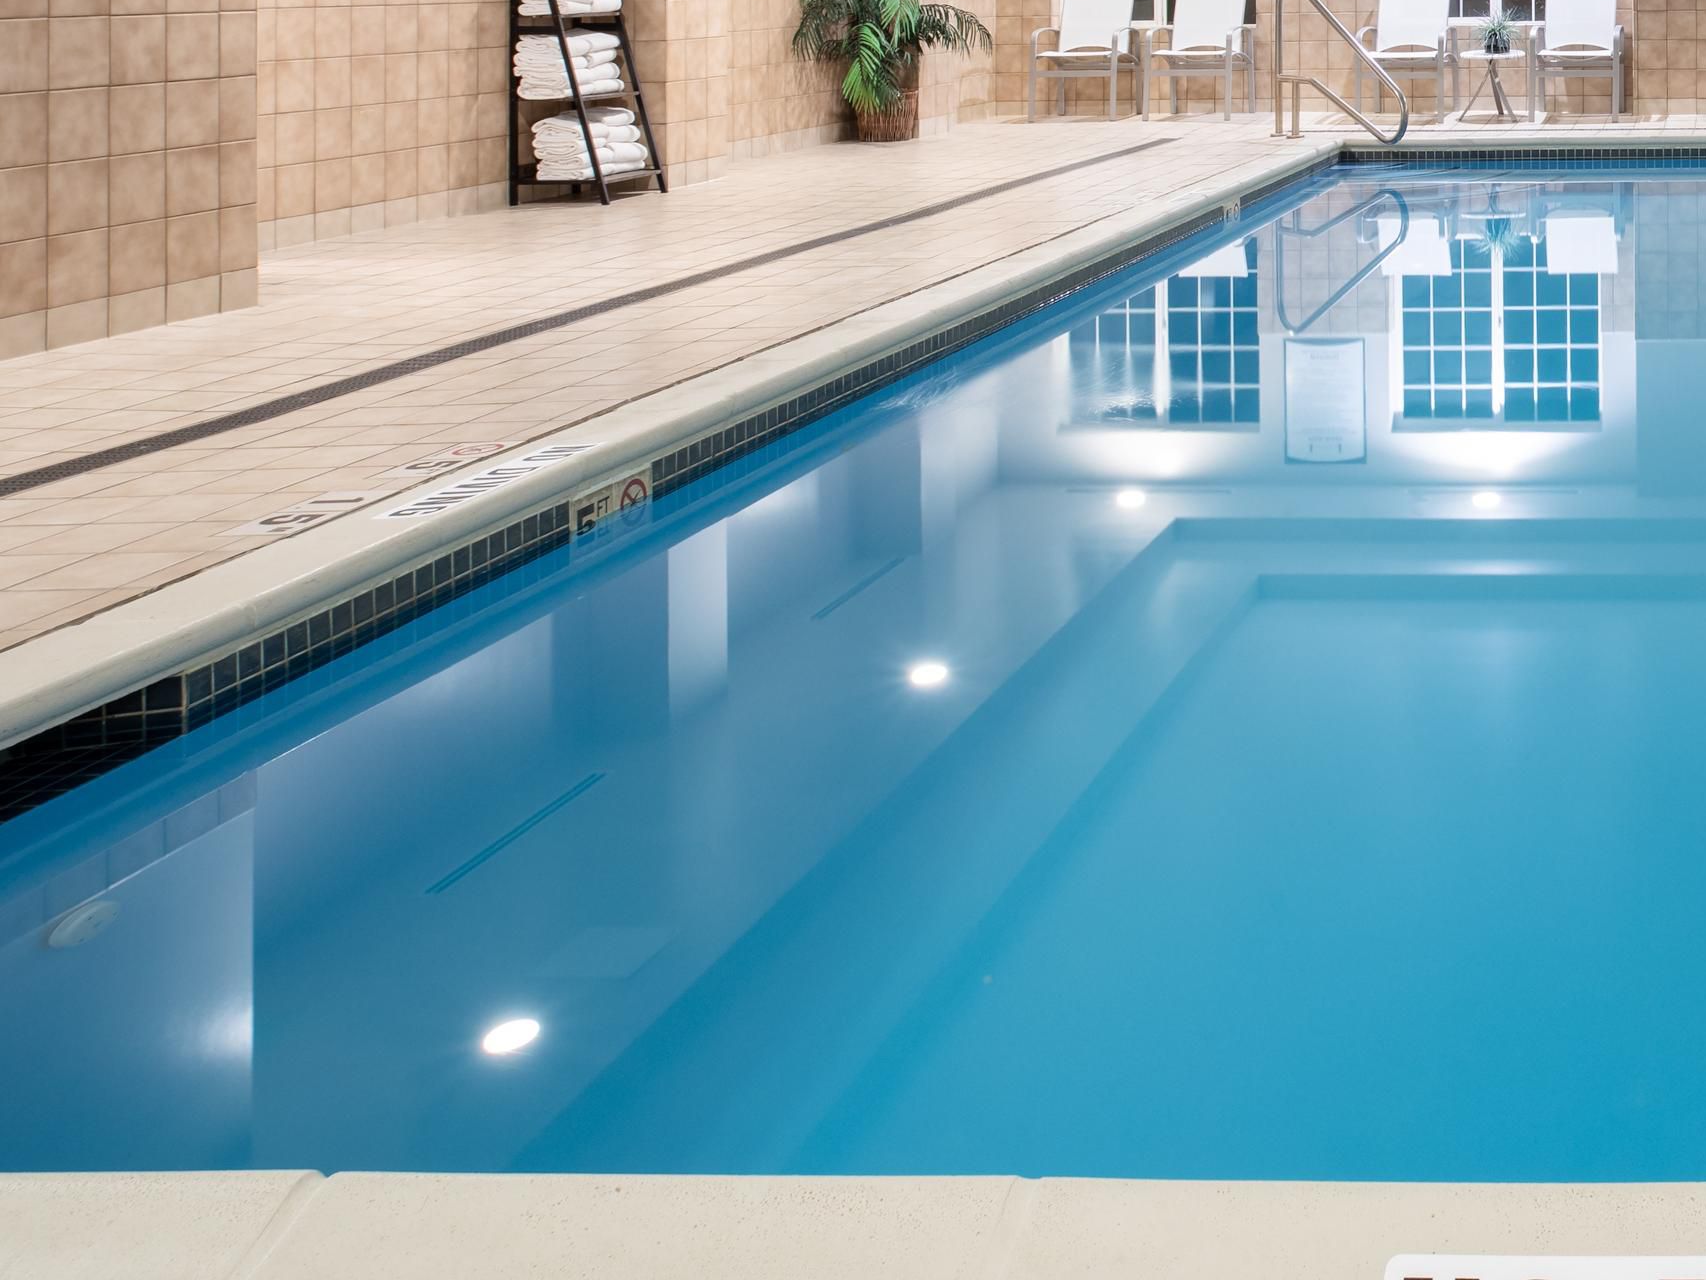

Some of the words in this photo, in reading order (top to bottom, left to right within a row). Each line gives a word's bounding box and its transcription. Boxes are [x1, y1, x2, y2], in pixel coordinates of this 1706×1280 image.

[522, 443, 596, 462] NO
[388, 465, 541, 518] DIVING
[576, 502, 597, 534] 5
[597, 495, 610, 518] FT
